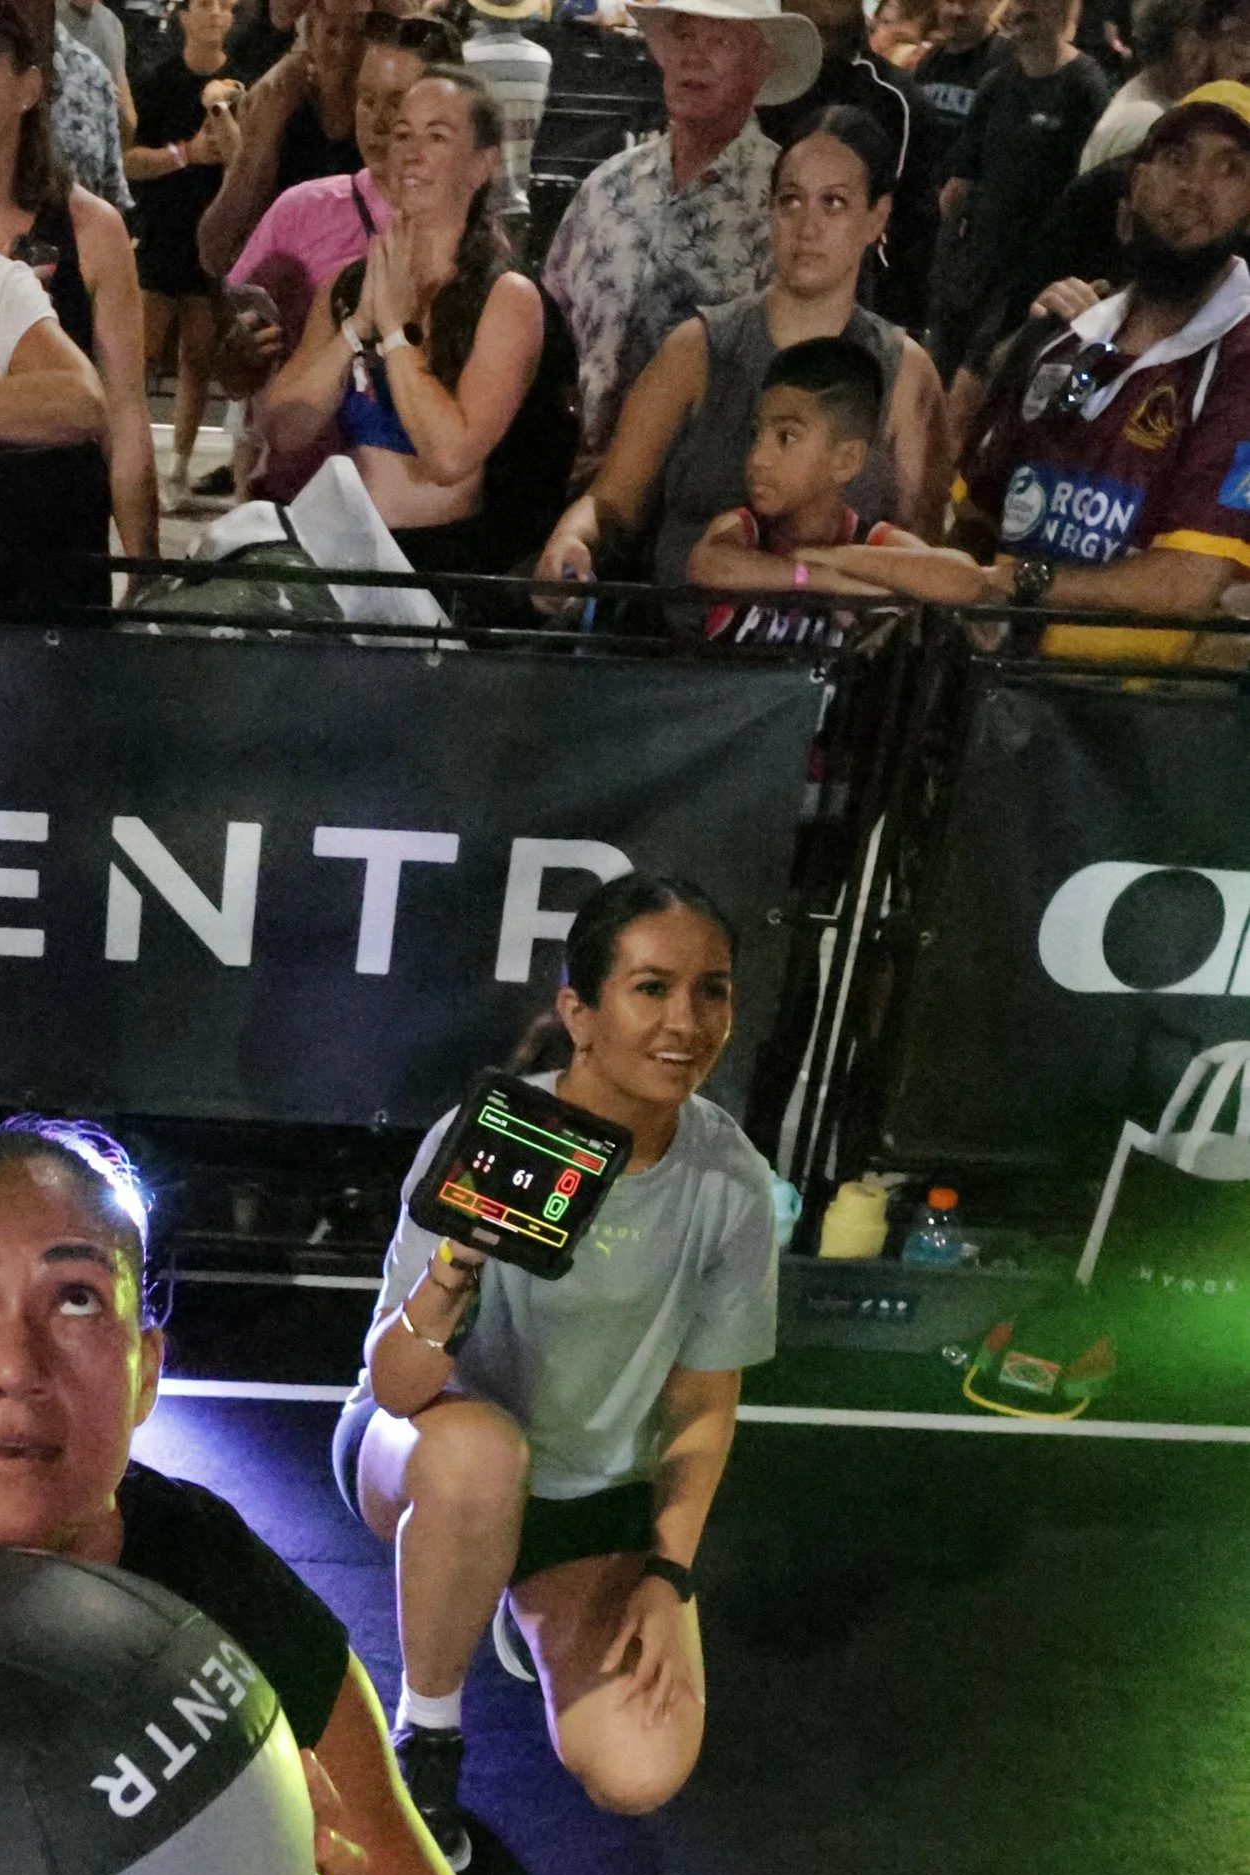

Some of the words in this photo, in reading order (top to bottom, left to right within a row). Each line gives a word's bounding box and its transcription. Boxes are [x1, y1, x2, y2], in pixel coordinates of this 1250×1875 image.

[1051, 481, 1135, 534] RGON
[512, 1169, 534, 1190] 61
[90, 1639, 257, 1818] CENTR
